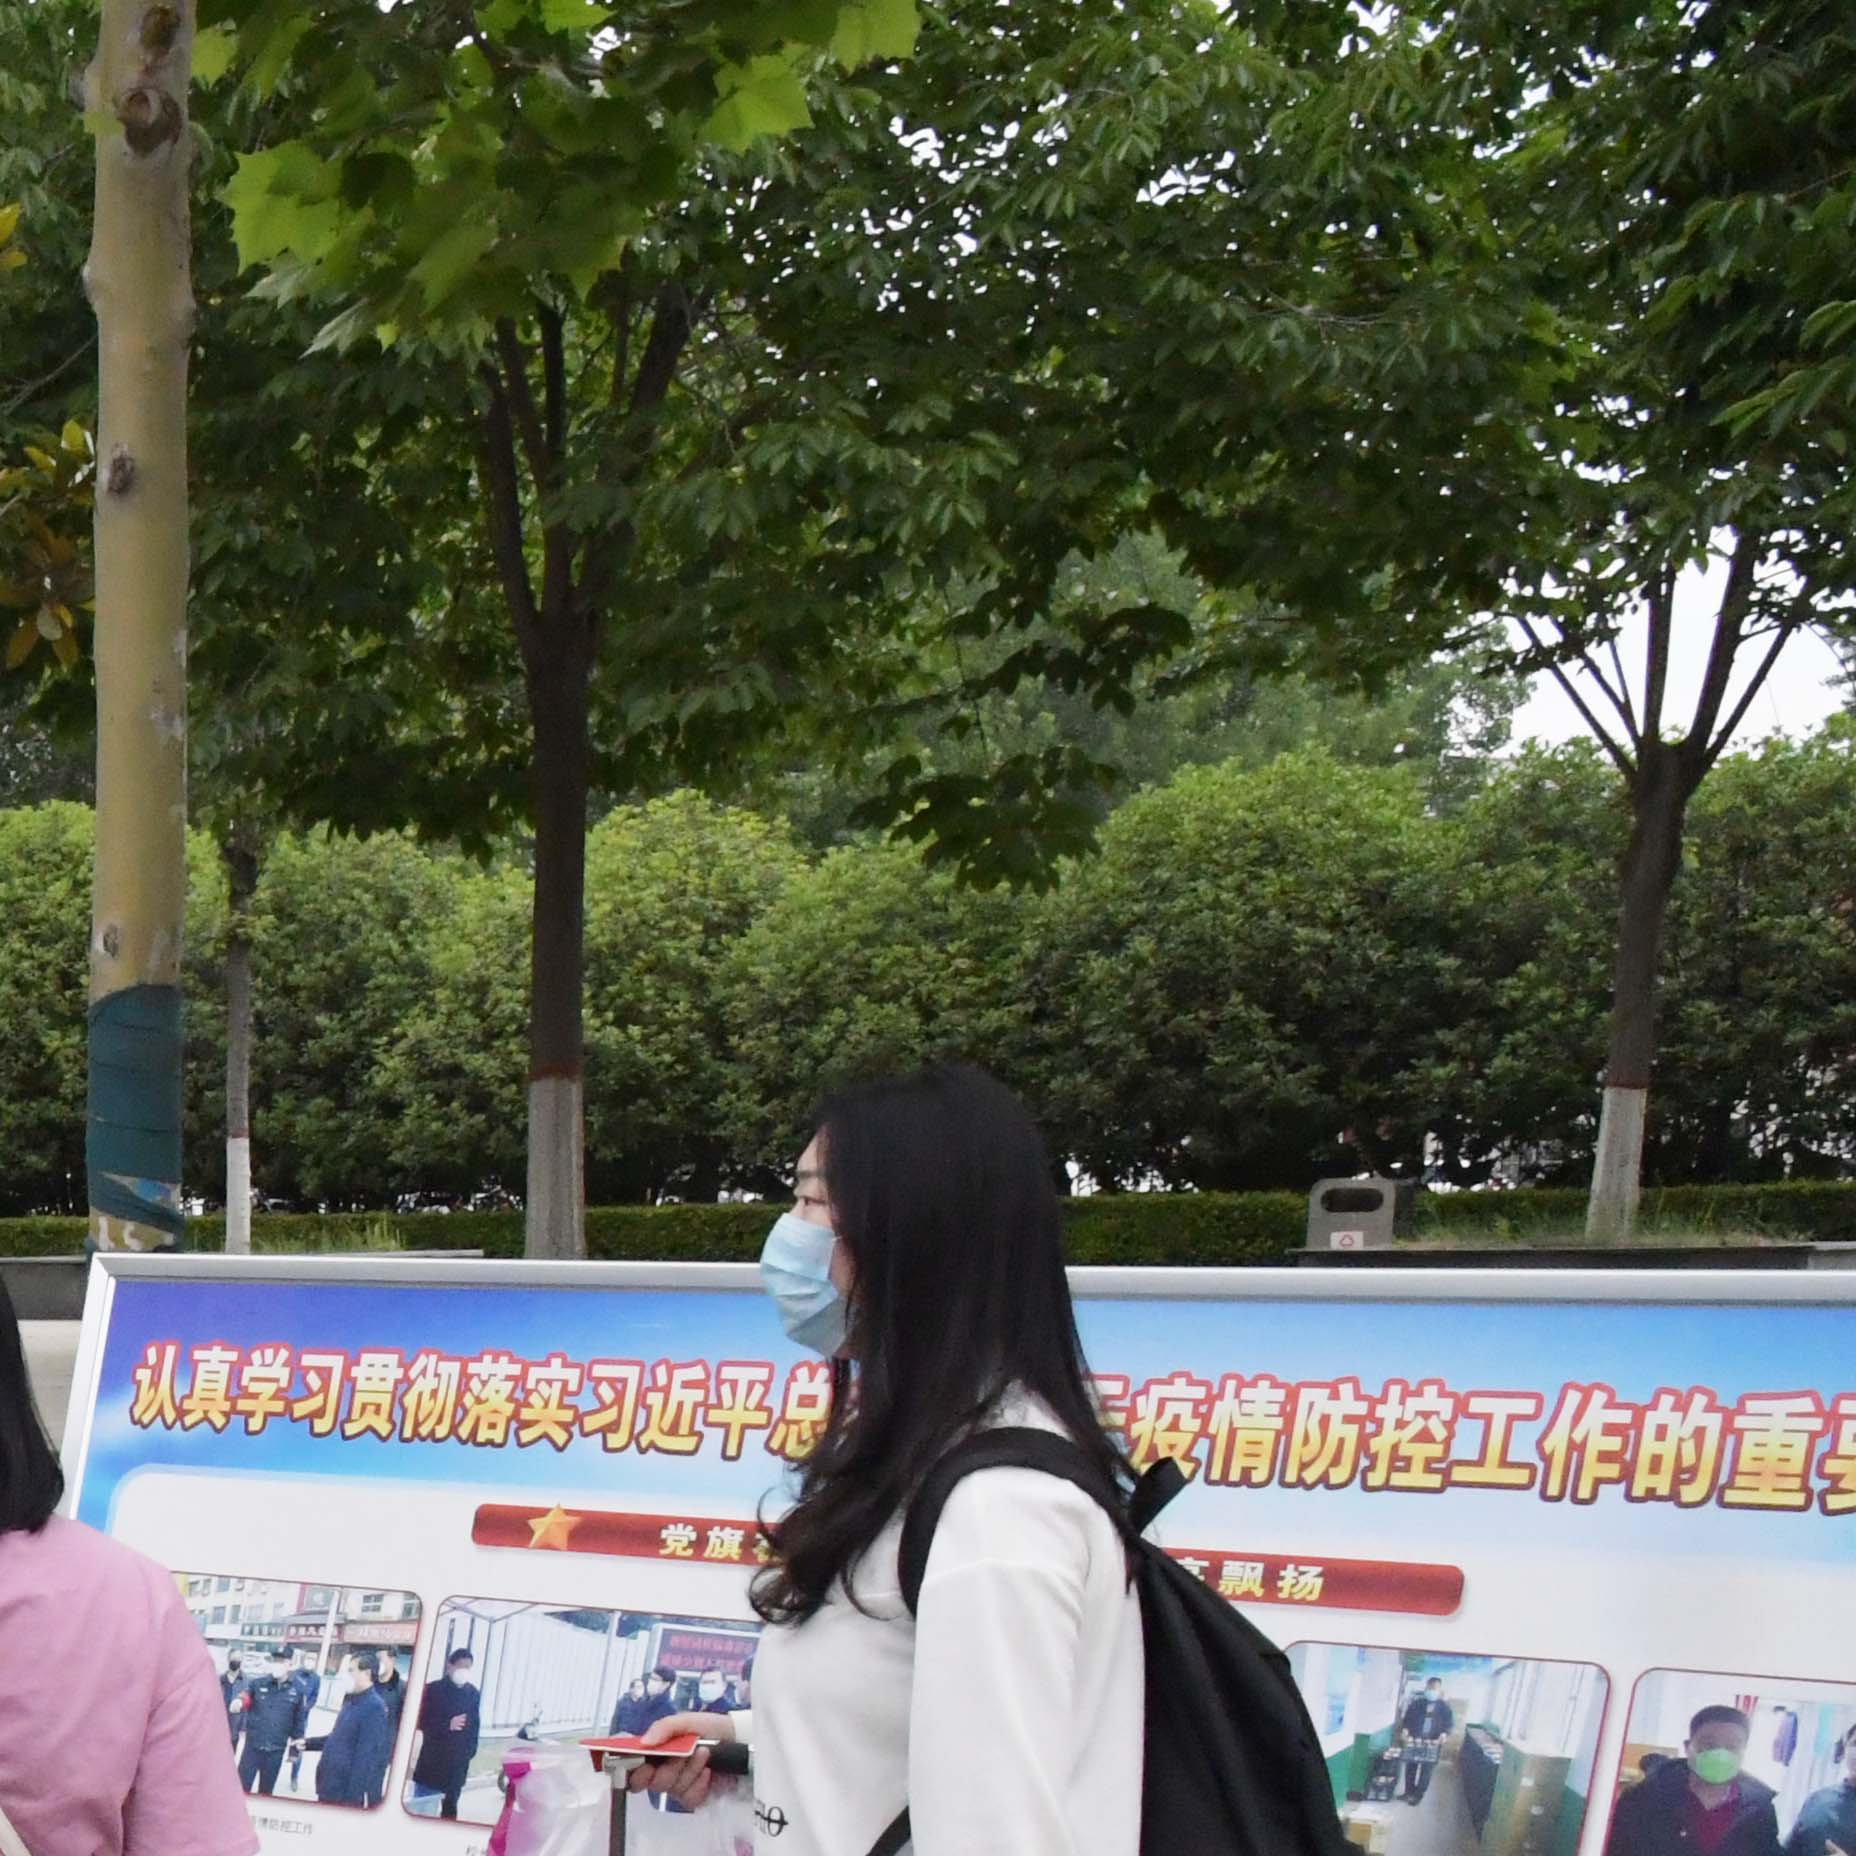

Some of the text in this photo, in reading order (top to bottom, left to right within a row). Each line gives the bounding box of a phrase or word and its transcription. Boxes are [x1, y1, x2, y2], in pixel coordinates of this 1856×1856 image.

[131, 1343, 833, 1461] 认真学习贯彻落实习近平总
